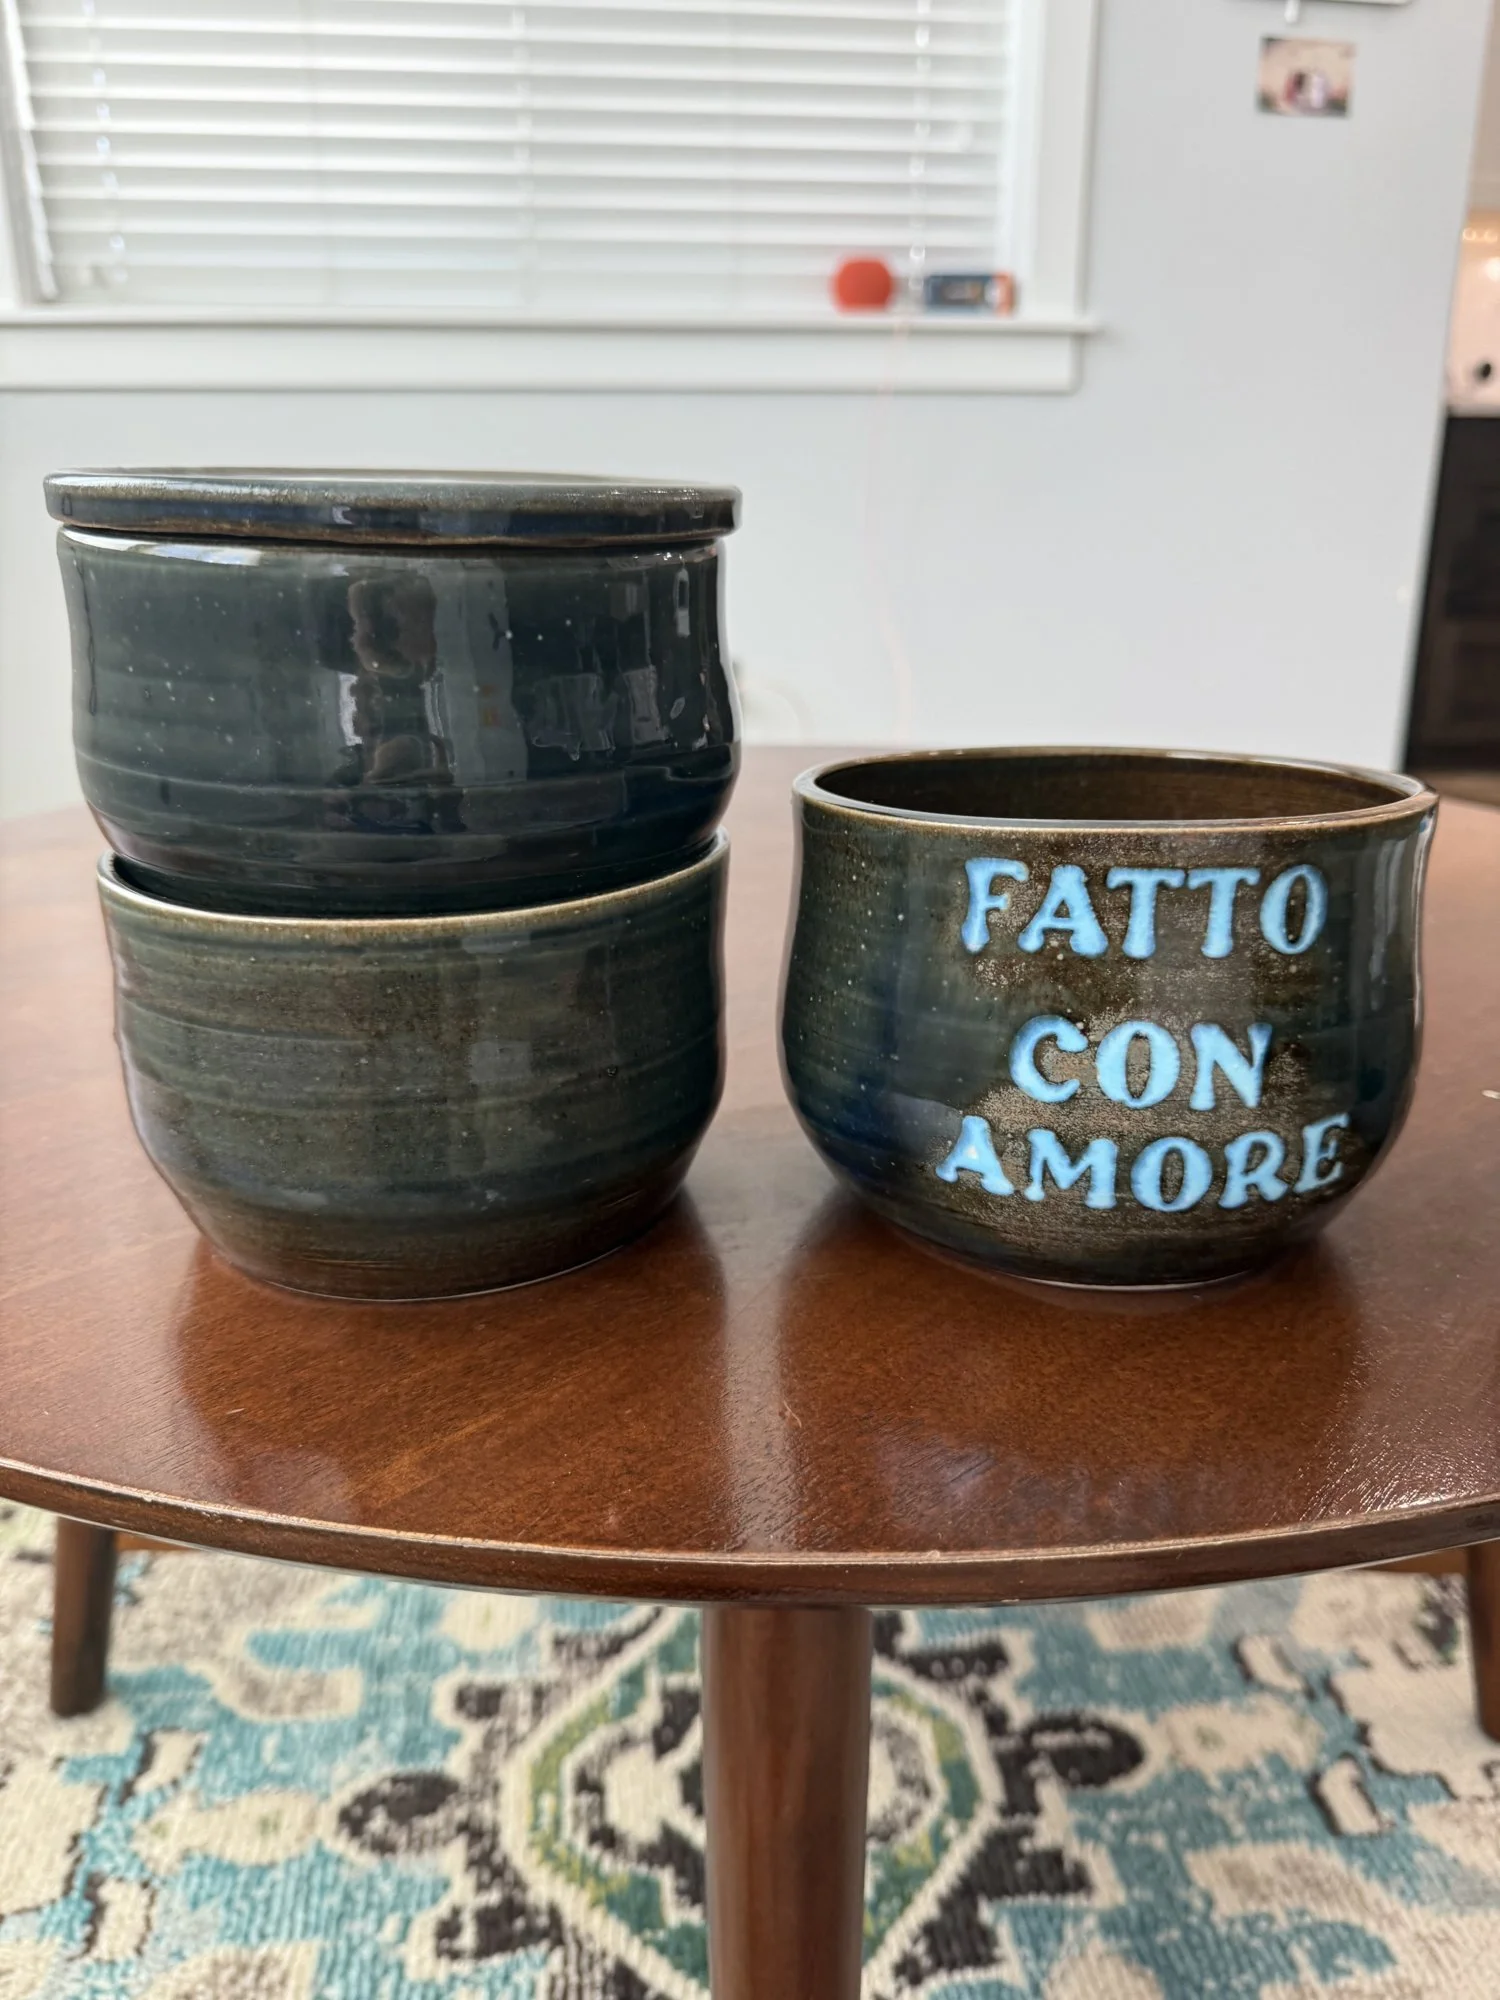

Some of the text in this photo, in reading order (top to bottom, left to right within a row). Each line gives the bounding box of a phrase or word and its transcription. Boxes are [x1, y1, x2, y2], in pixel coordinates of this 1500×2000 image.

[961, 857, 1328, 959] FATTO
[1009, 1014, 1272, 1111] CON
[935, 1114, 1349, 1212] AMORE
